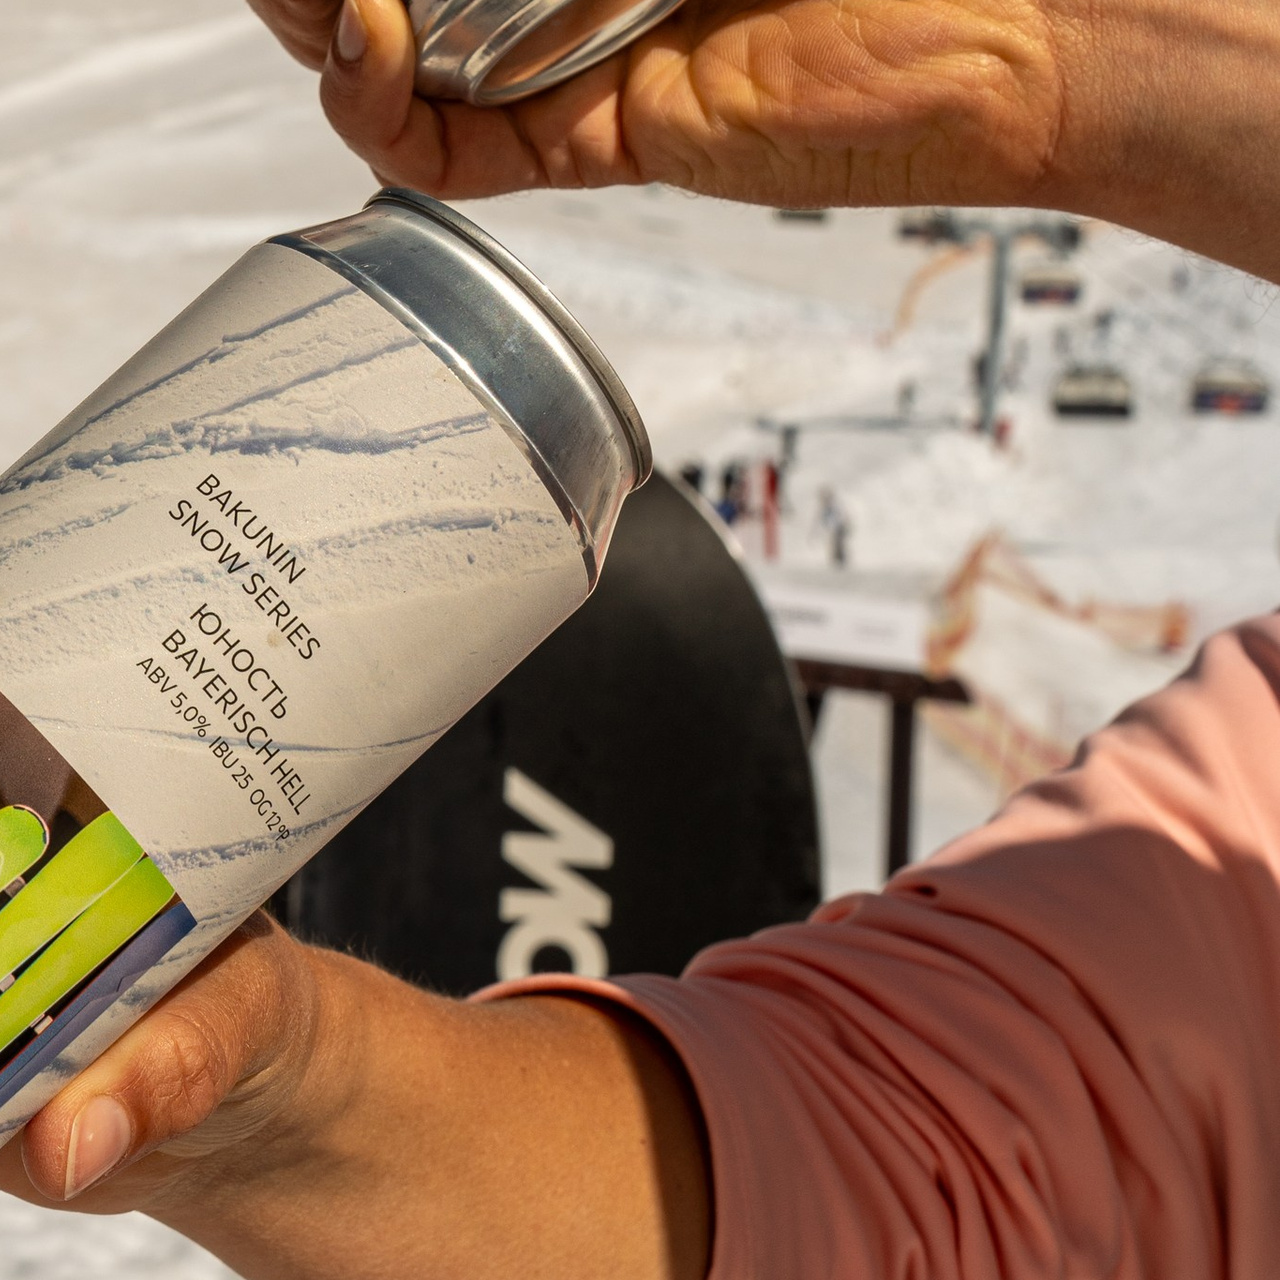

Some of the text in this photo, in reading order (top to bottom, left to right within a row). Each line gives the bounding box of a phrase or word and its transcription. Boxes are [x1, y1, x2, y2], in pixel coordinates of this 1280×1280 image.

[169, 500, 320, 659] SNOW SERIES
[196, 474, 305, 584] BAKUNIN
[137, 658, 177, 693] ABV
[172, 693, 210, 738] 5,0%
[209, 737, 239, 769] IBU
[232, 766, 253, 789] 25
[250, 789, 272, 815] OG
[162, 630, 311, 815] BAYERISCH HELL
[190, 603, 287, 719] ЮНОСТЬ
